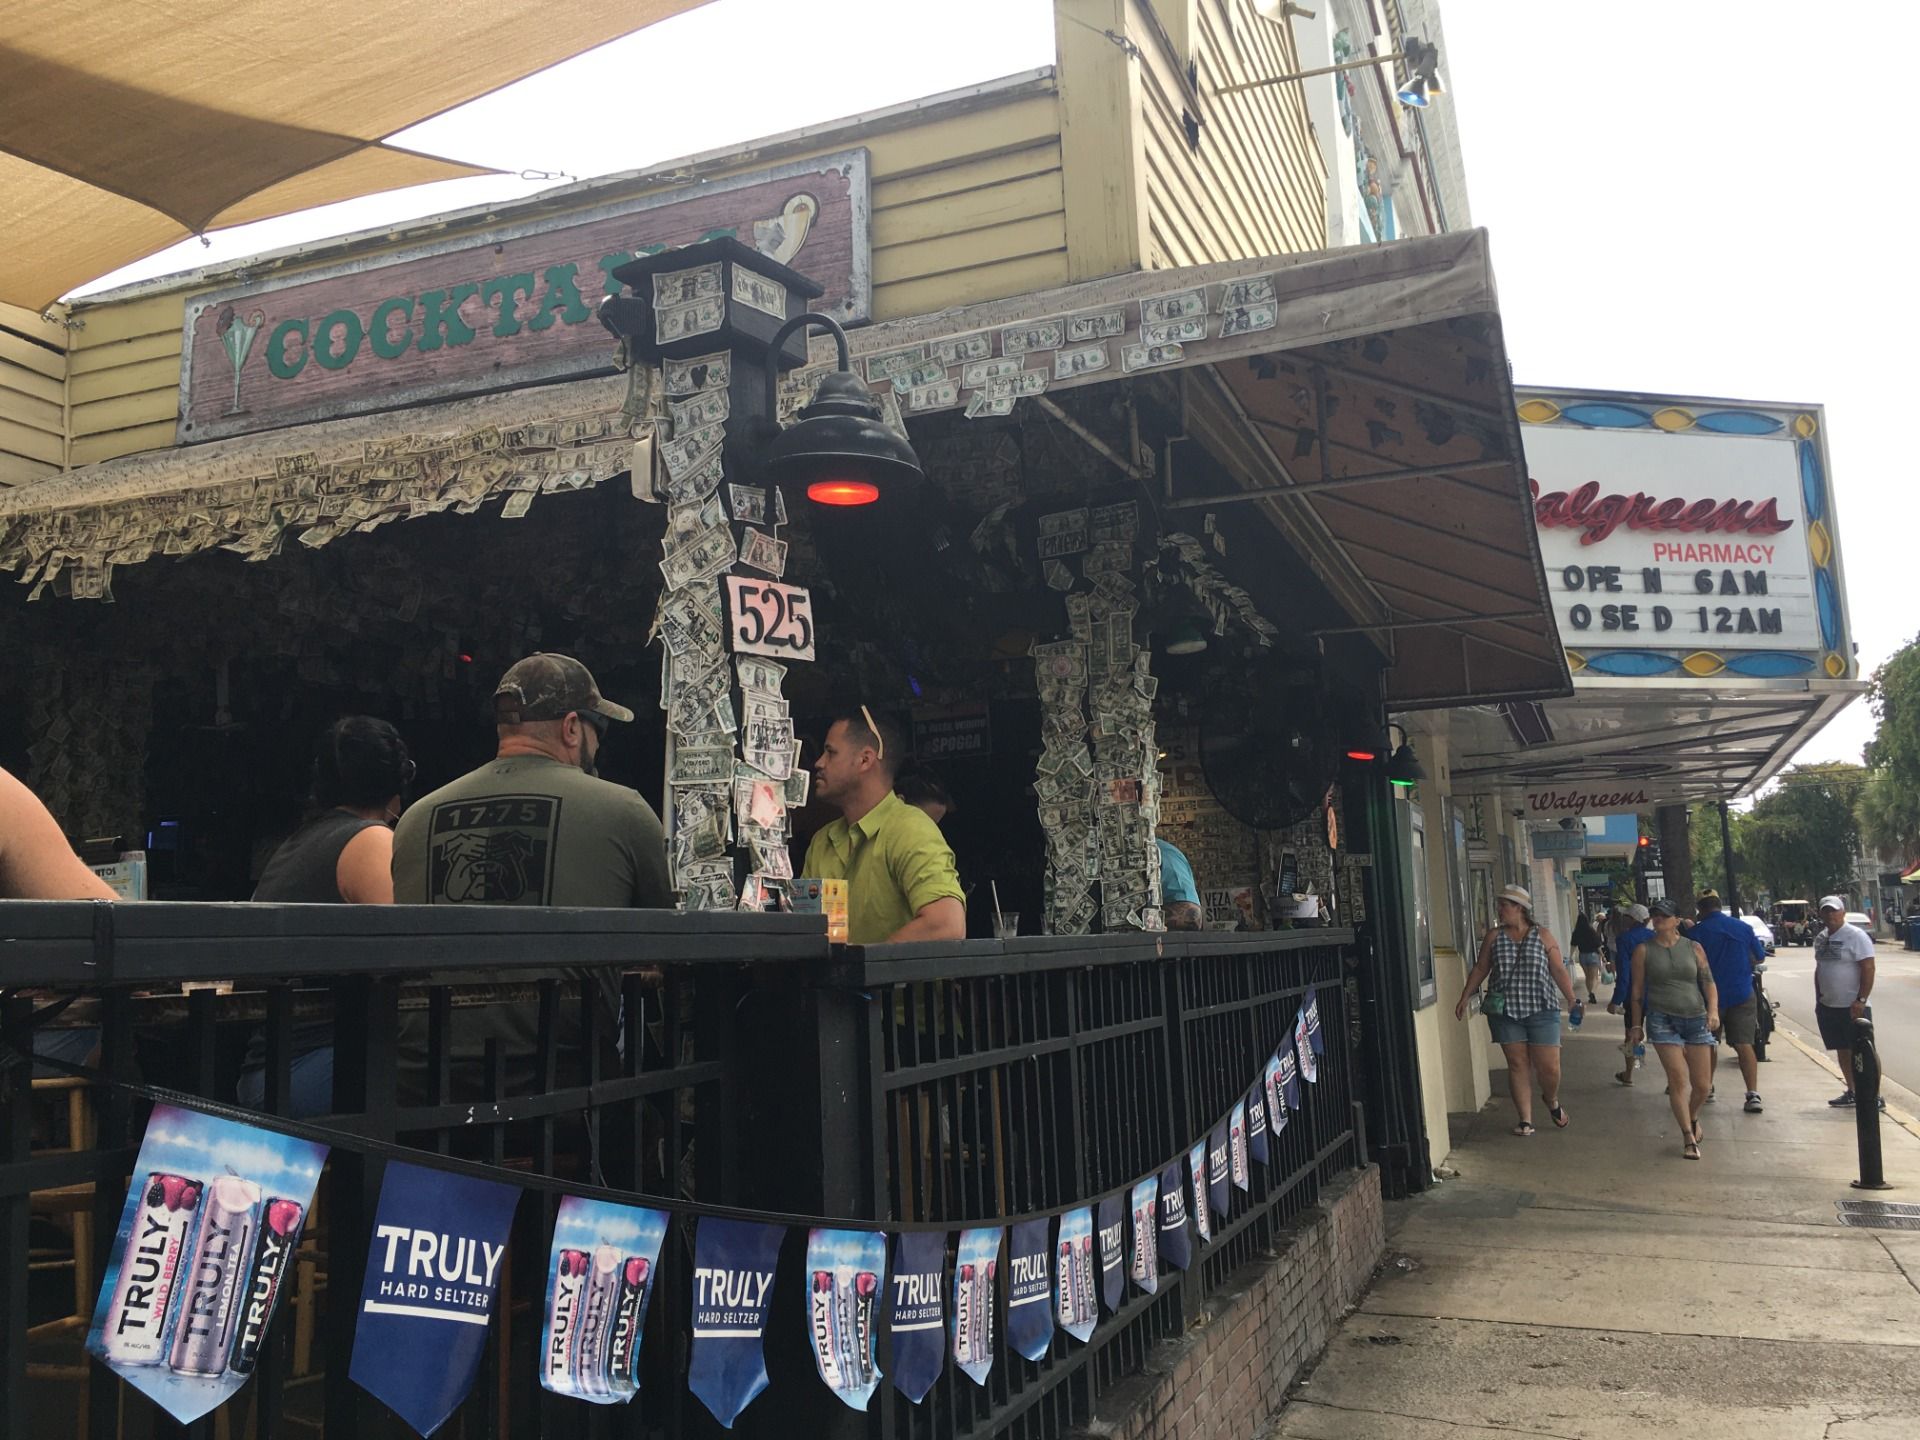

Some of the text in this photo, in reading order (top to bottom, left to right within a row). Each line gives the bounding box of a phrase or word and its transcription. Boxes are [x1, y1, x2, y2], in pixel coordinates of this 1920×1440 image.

[265, 228, 736, 379] COCKTAI
[1529, 478, 1794, 546] algreens
[1654, 543, 1775, 564] PHARMACY
[739, 585, 811, 650] 525
[1700, 607, 1782, 633] 12AM
[449, 803, 537, 827] 1775
[1528, 790, 1648, 815] Walgreens
[1205, 892, 1231, 907] VEZA
[1249, 1100, 1264, 1124] TRU
[117, 1213, 169, 1334] TRULY
[152, 1238, 180, 1320] WILD BERRY
[182, 1218, 231, 1343] TRULY
[377, 1225, 504, 1287] TRULY
[1011, 1252, 1048, 1285] TRULY
[216, 1243, 241, 1327] LEMON TEA
[241, 1235, 281, 1350] TRULY
[380, 1281, 489, 1308] HARD SELTZER
[695, 1268, 773, 1308] TRULY
[893, 1273, 942, 1306] TRULY
[895, 1306, 941, 1321] HARD SELTZER
[1013, 1285, 1028, 1297] HARD
[1061, 1262, 1069, 1315] TRULY
[551, 1281, 573, 1375] TRULY
[580, 1280, 604, 1376] TRULY
[611, 1287, 636, 1375] TRULY
[698, 1312, 760, 1325] HARD SELTZER
[814, 1297, 835, 1373] TRULY
[959, 1287, 969, 1350] TRULY
